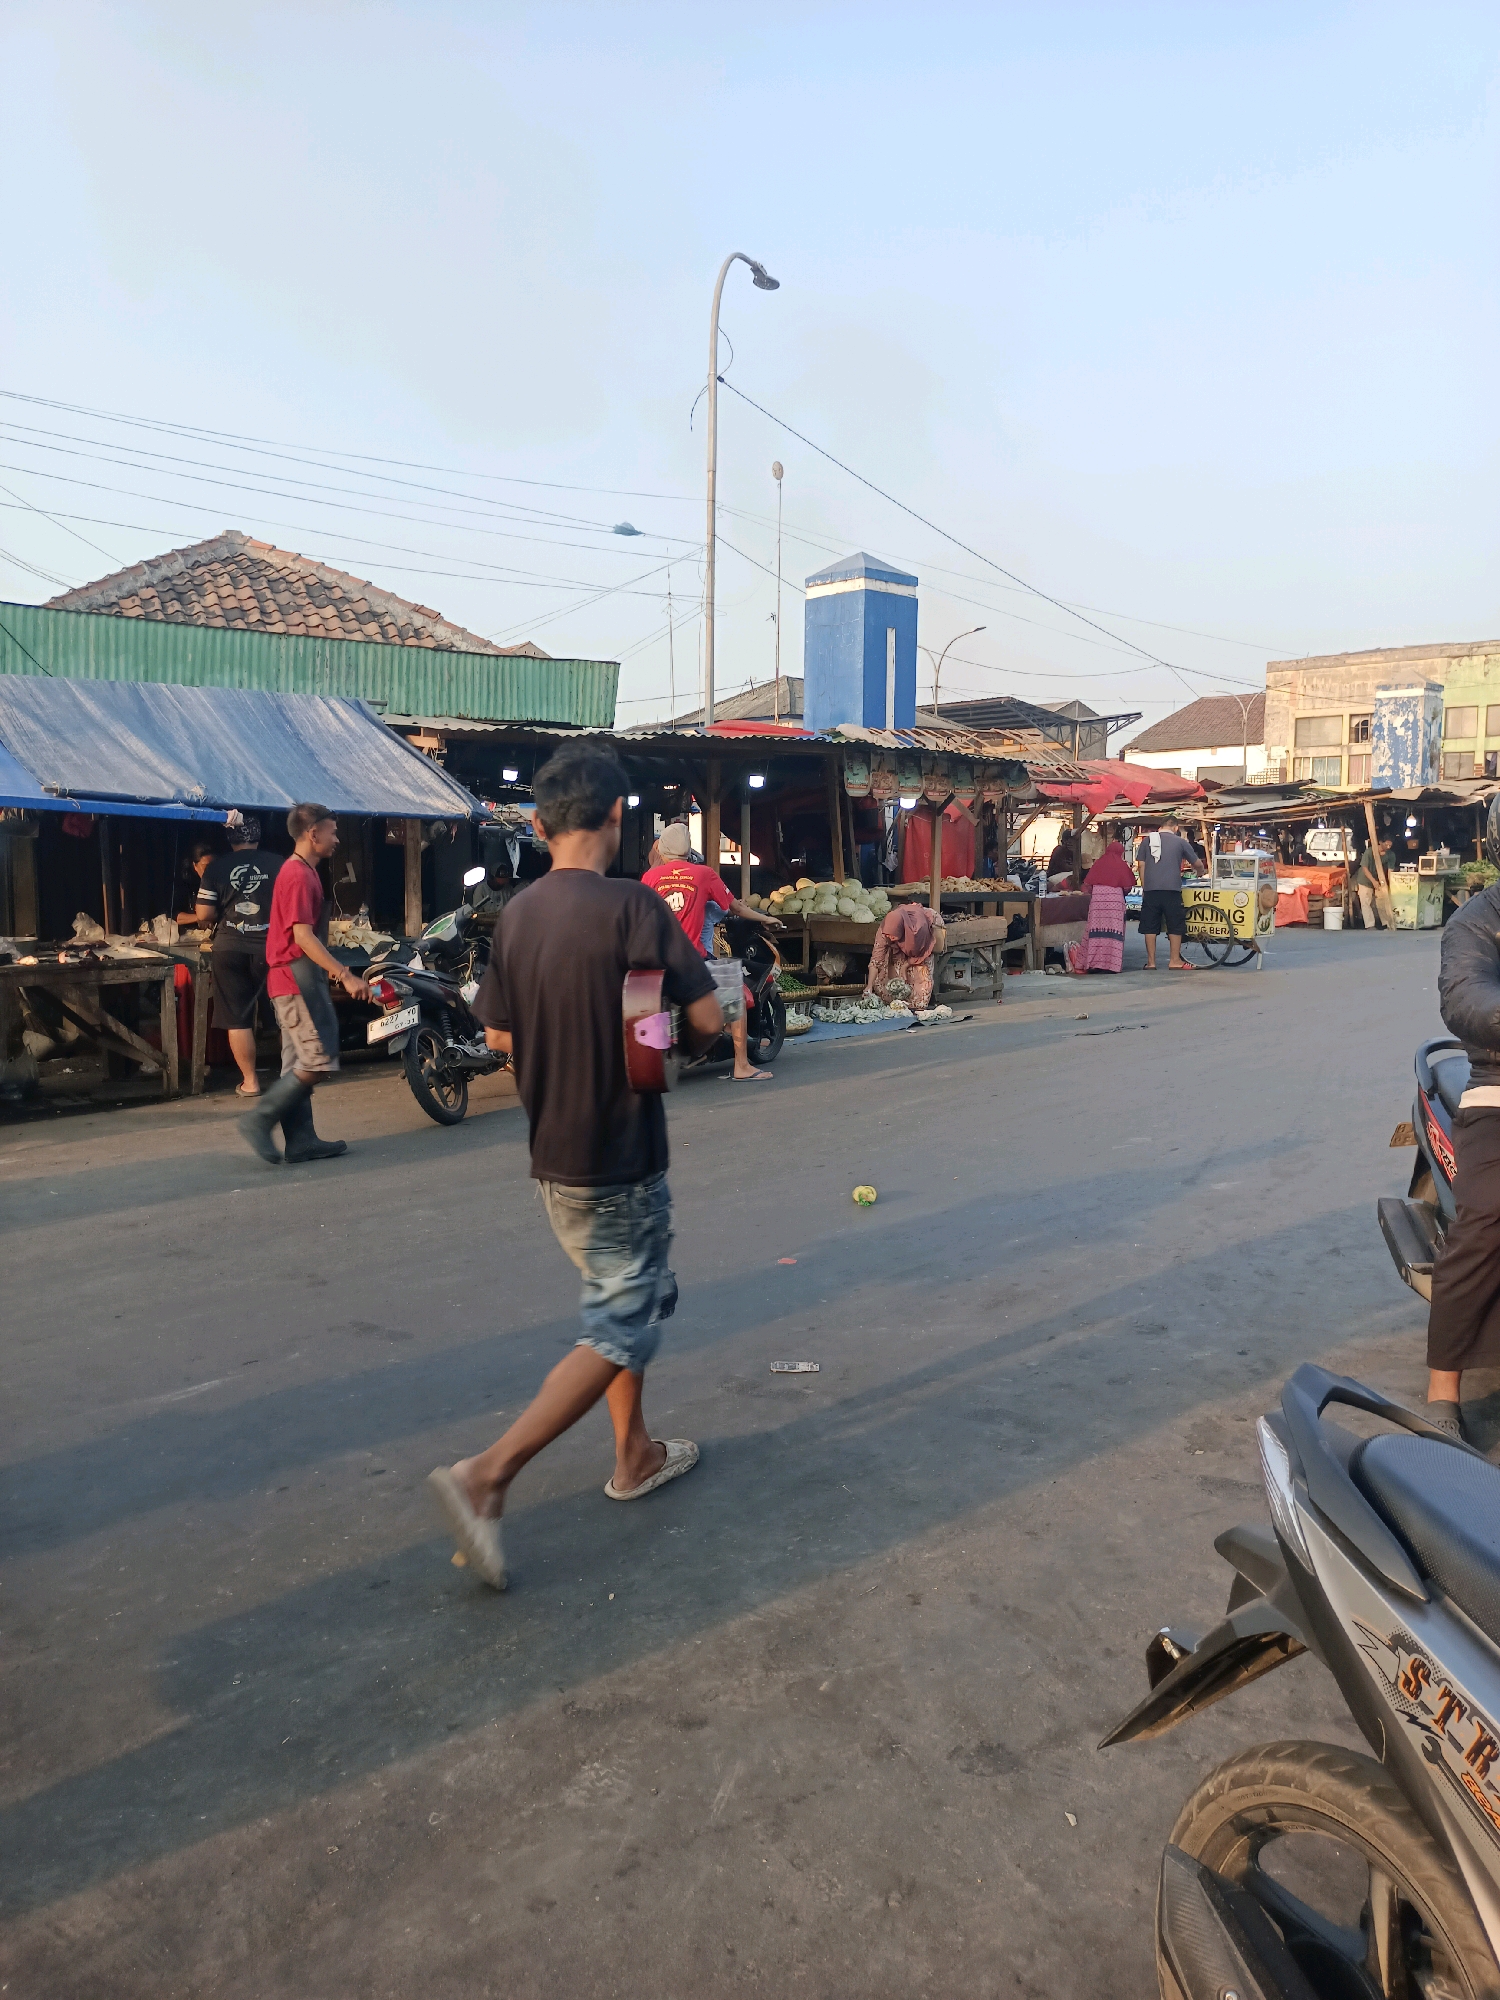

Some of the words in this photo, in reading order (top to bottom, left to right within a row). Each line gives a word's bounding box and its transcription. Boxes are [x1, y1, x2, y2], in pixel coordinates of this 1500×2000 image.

[1193, 891, 1220, 903] KUE
[1185, 907, 1244, 923] ONJING
[1399, 1656, 1500, 1782] STR
